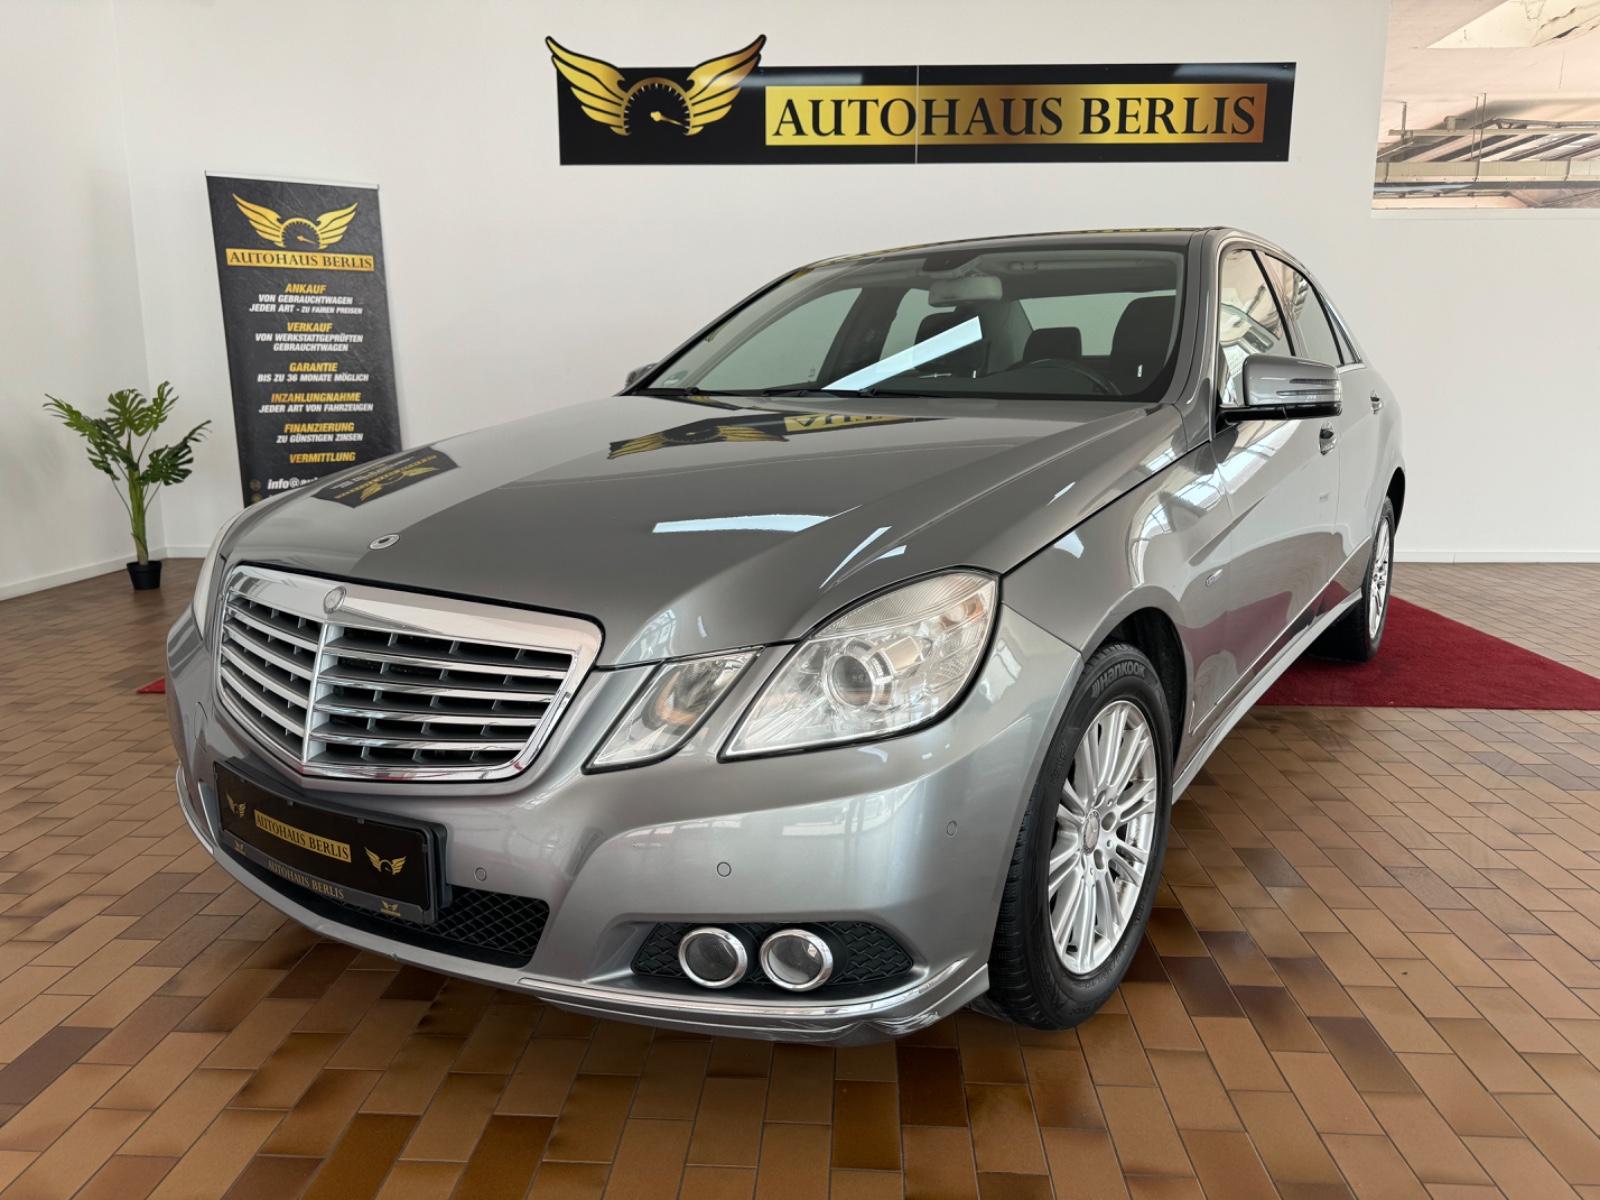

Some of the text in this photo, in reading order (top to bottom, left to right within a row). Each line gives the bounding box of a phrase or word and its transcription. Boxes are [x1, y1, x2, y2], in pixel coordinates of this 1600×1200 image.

[773, 95, 1256, 137] AUTOHAUS BERLIS
[230, 251, 372, 269] AUTOHAUS BERLIS
[285, 283, 326, 294] ANKAUF
[258, 294, 353, 305] VON GEBRAUCHTWAGEN
[249, 303, 276, 313] JEDER
[278, 304, 294, 313] ART
[301, 306, 311, 314] ZU
[312, 306, 335, 314] FAIREN
[336, 307, 363, 315] PREISEN
[287, 322, 333, 332] VERKAUF
[255, 332, 363, 343] VON WERKSTATTGEPRÜFTEN
[273, 342, 349, 352] GEBRAUCHTWAGEN
[289, 362, 338, 372] GARANTIE
[257, 372, 369, 382] BIS ZU 36 MONATE MÖGLICH
[271, 392, 362, 403] INZAHLUNGNAHME
[258, 403, 373, 413] JEDER ART VON FAHRZEUGEN
[284, 422, 355, 433] FINANZIERUNG
[276, 433, 363, 444] ZU GÜNSTIGEN ZINSEN
[289, 452, 356, 463] VERMITTLUNG
[267, 477, 318, 490] info@
[256, 815, 350, 860] AUTOHAUS BERLIS
[267, 859, 345, 899] AUTOHAUS BERLIS
